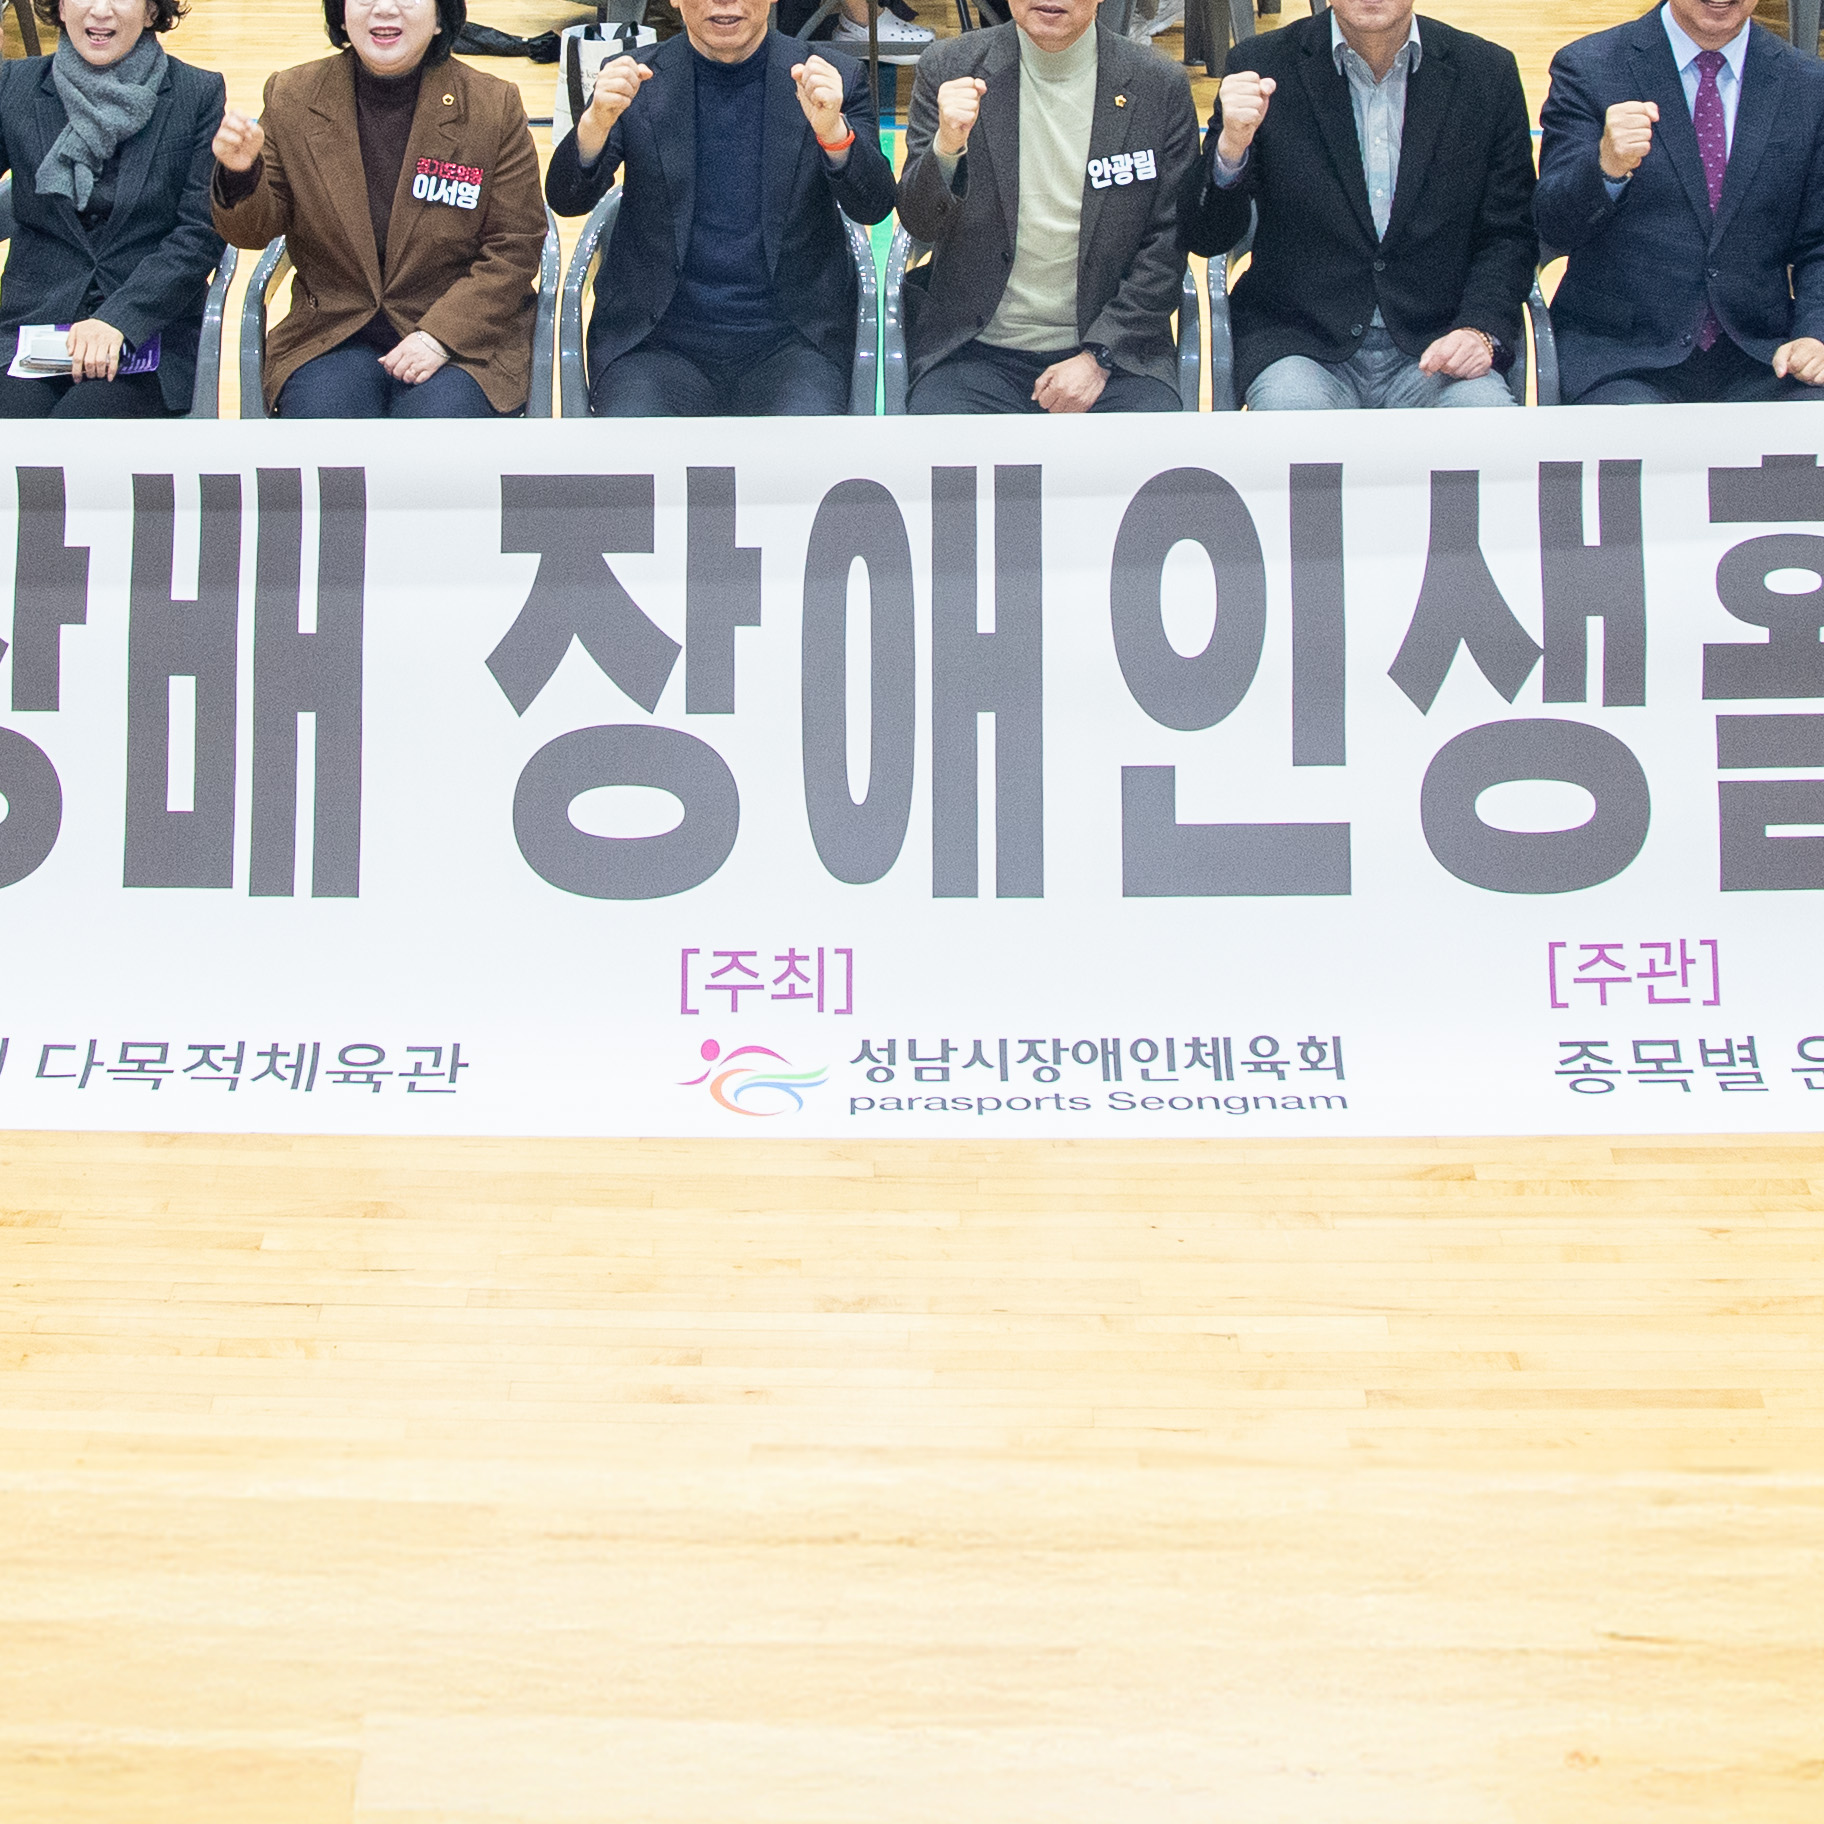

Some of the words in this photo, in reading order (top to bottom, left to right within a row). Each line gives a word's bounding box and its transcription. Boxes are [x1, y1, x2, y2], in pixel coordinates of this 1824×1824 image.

[412, 173, 481, 210] 이서영
[1087, 149, 1157, 190] 안광림
[679, 946, 854, 1016] [주최]
[1548, 938, 1721, 1009] [주관]
[34, 1038, 470, 1095] 다목적체육관
[849, 1034, 1346, 1084] 성남시장애인체육회
[1554, 1035, 1769, 1095] 종목별
[849, 1093, 1093, 1117] parasports
[1108, 1091, 1348, 1117] Seongnam
